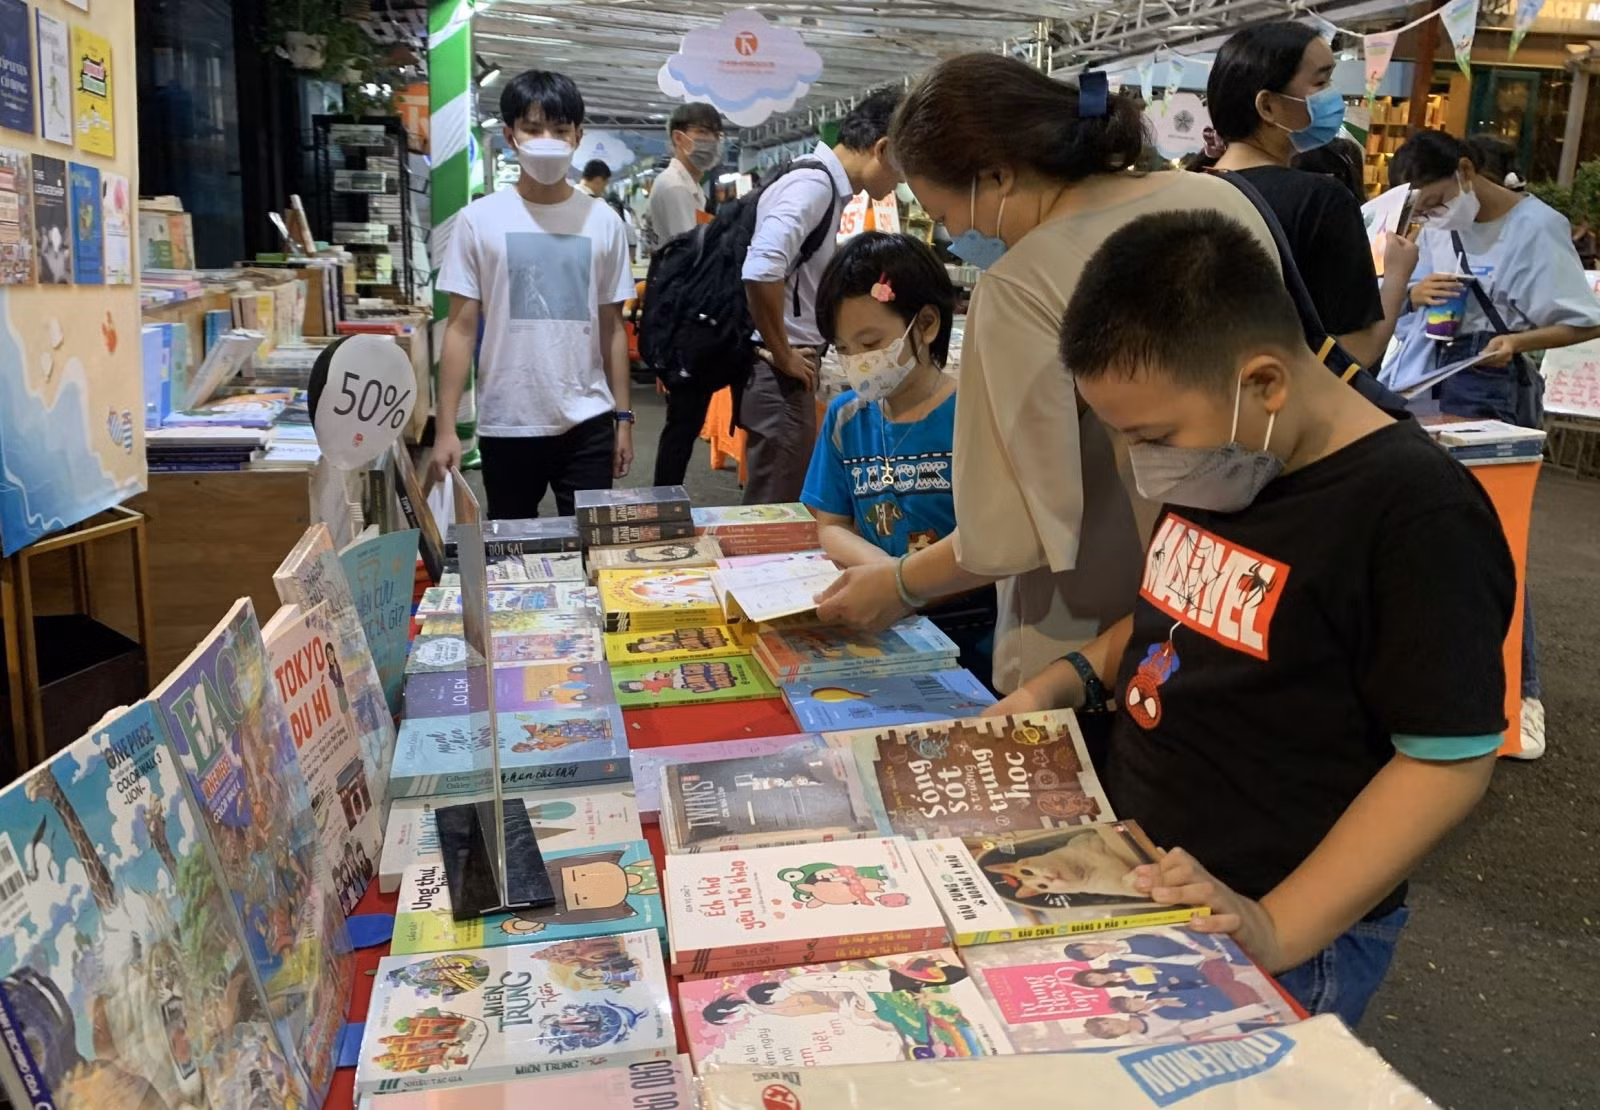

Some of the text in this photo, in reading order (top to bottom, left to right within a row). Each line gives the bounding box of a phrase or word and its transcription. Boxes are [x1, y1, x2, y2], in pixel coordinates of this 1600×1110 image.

[333, 372, 411, 429] 50%
[852, 461, 951, 495] LUCK
[1143, 517, 1277, 651] MARVEL
[274, 636, 326, 704] TOKYO
[289, 707, 313, 750] DU
[311, 677, 333, 728] HÍ
[127, 721, 154, 755] PIECE
[116, 769, 140, 793] COLOR
[908, 759, 948, 817] Sống
[934, 765, 970, 816] sót
[963, 764, 981, 803] trường
[972, 748, 1008, 813] trung
[997, 749, 1036, 802] học
[681, 780, 721, 830] TWINS
[412, 887, 439, 910] Ung
[727, 887, 753, 908] Thỏ
[944, 882, 967, 903] CUNG
[735, 909, 765, 931] yêu
[1035, 927, 1054, 936] CUNG
[481, 985, 507, 1018] MIỀN
[493, 969, 536, 1033] TRUNG
[828, 1018, 846, 1036] em
[544, 1060, 579, 1072] TRUNG
[801, 1048, 817, 1068] ạm
[1131, 1033, 1282, 1097] DORAEMON
